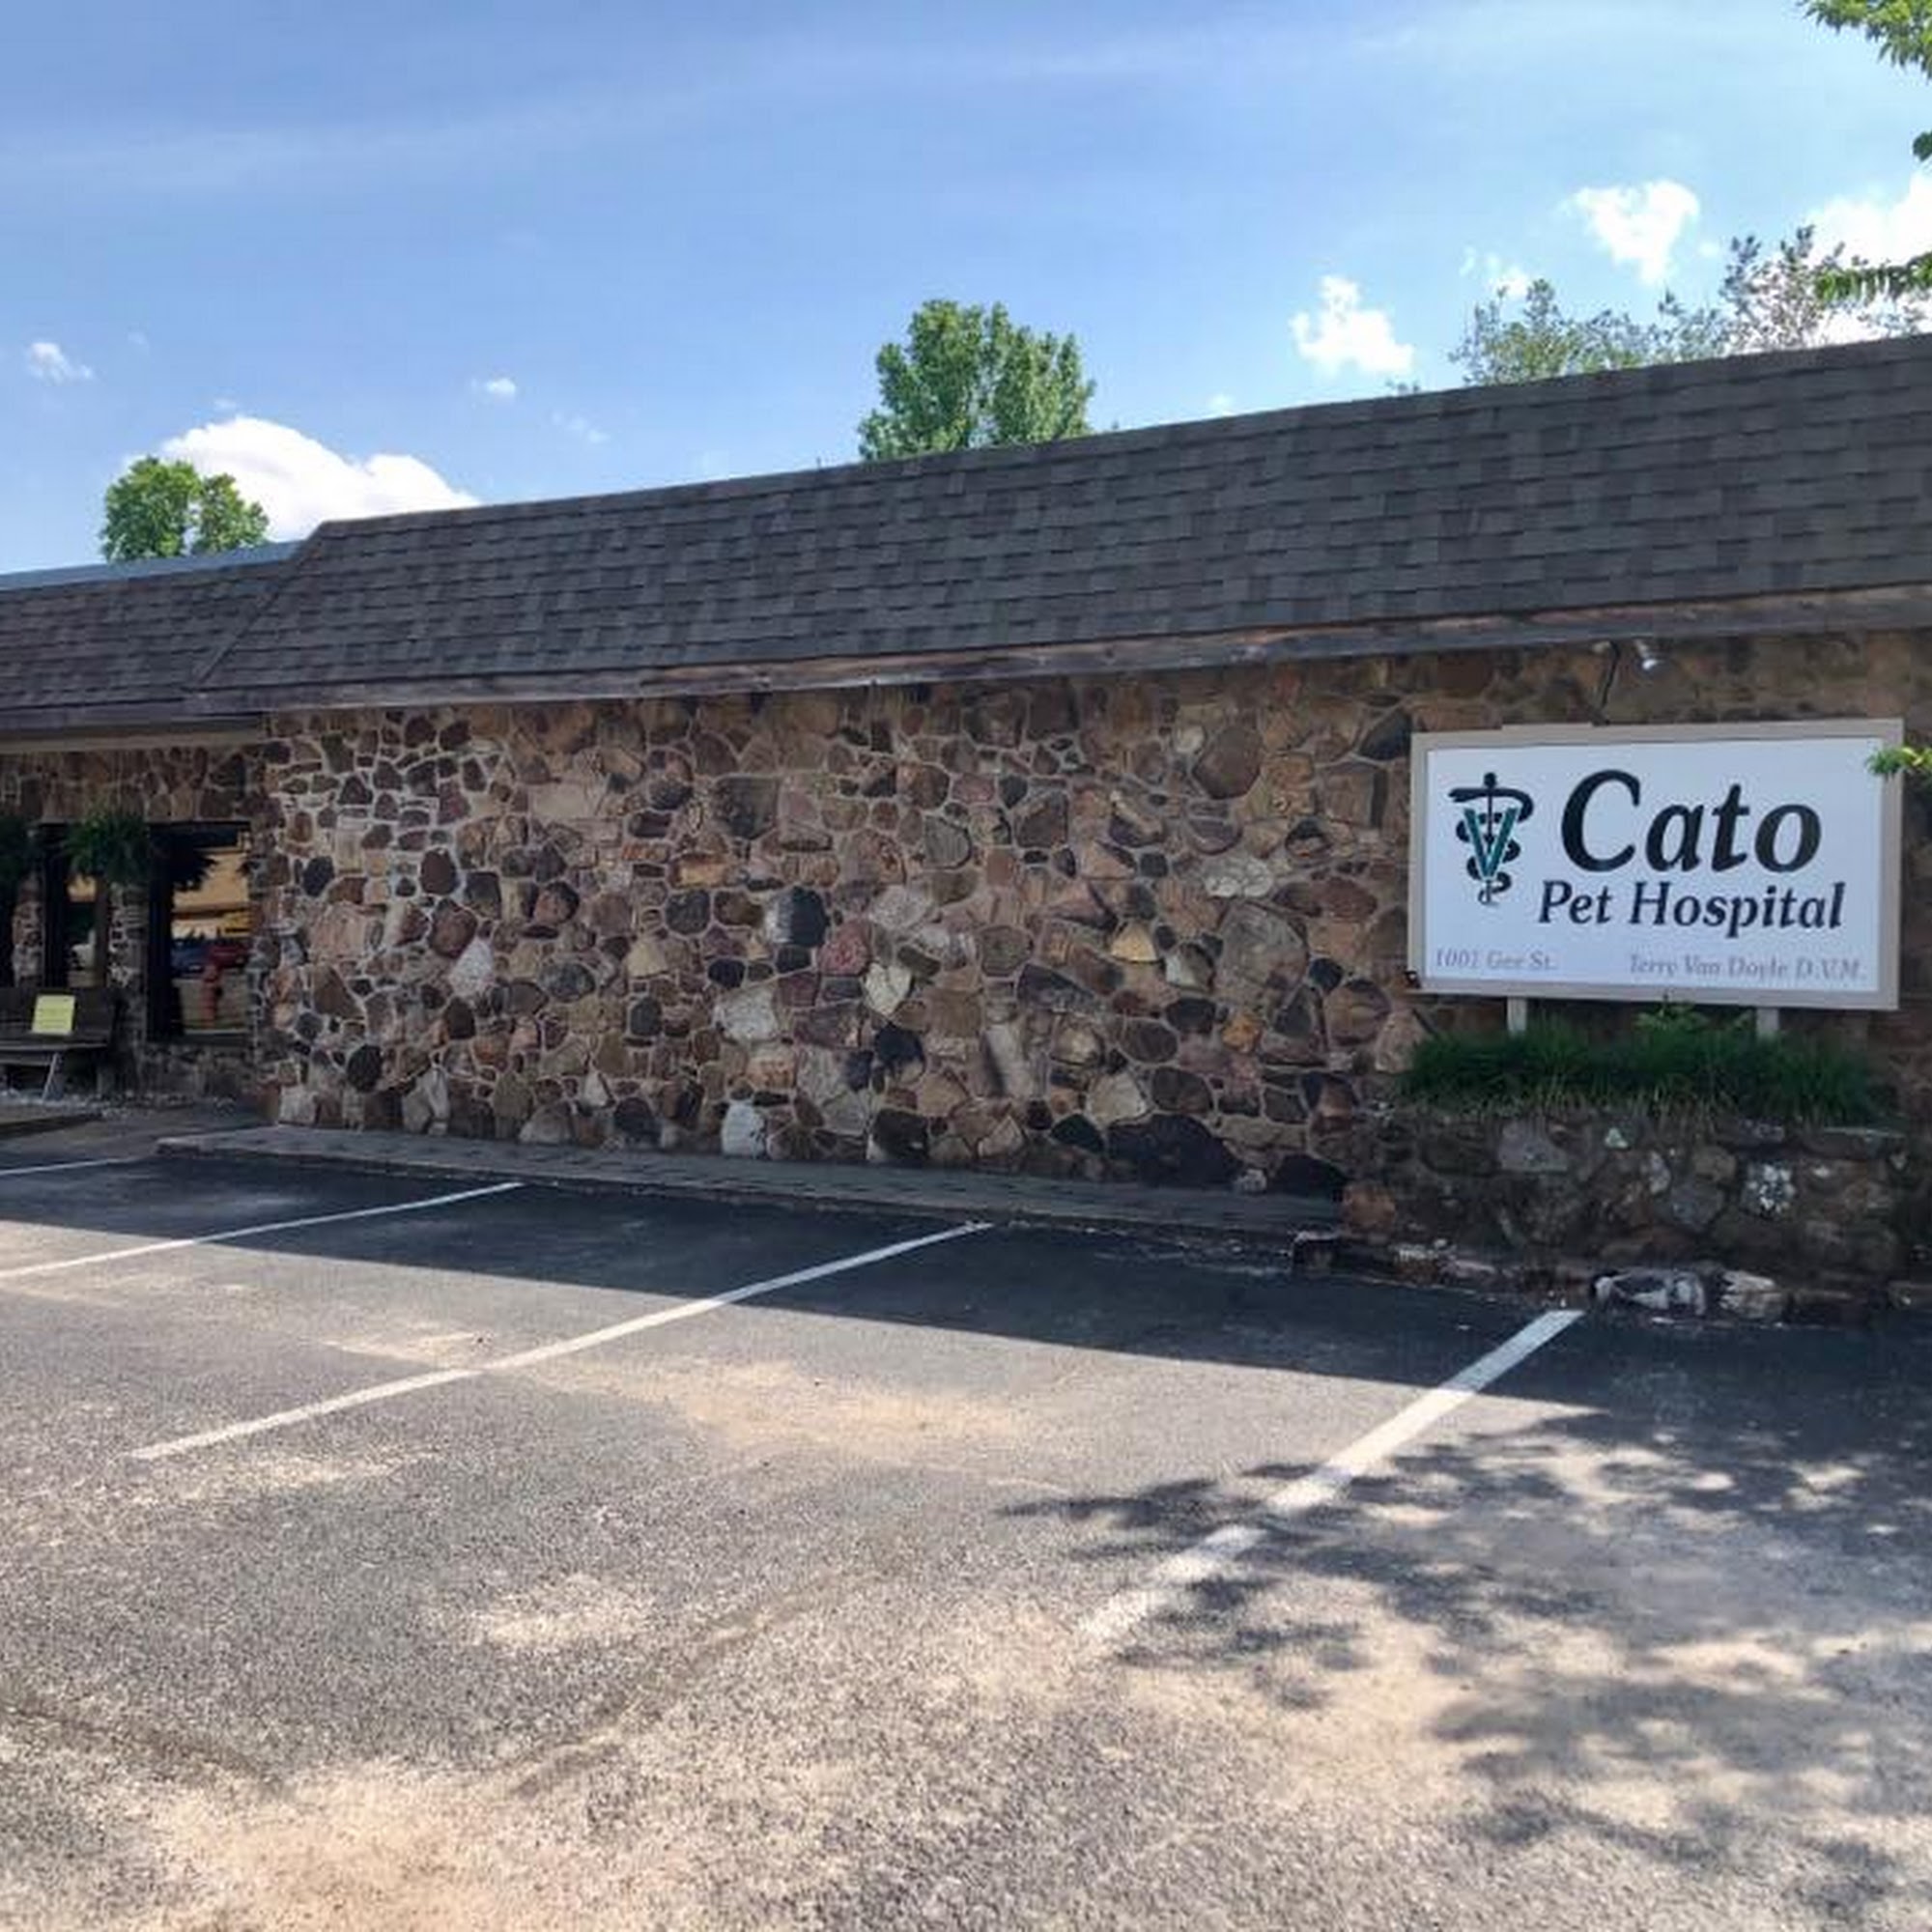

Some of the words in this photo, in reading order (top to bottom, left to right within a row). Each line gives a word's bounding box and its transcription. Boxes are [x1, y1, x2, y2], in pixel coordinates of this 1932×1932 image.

[1561, 769, 1822, 873] Cato
[1539, 880, 1612, 925] Pet
[1630, 881, 1846, 939] Hospital
[1629, 953, 1677, 978] Terry
[1685, 954, 1720, 976] Van
